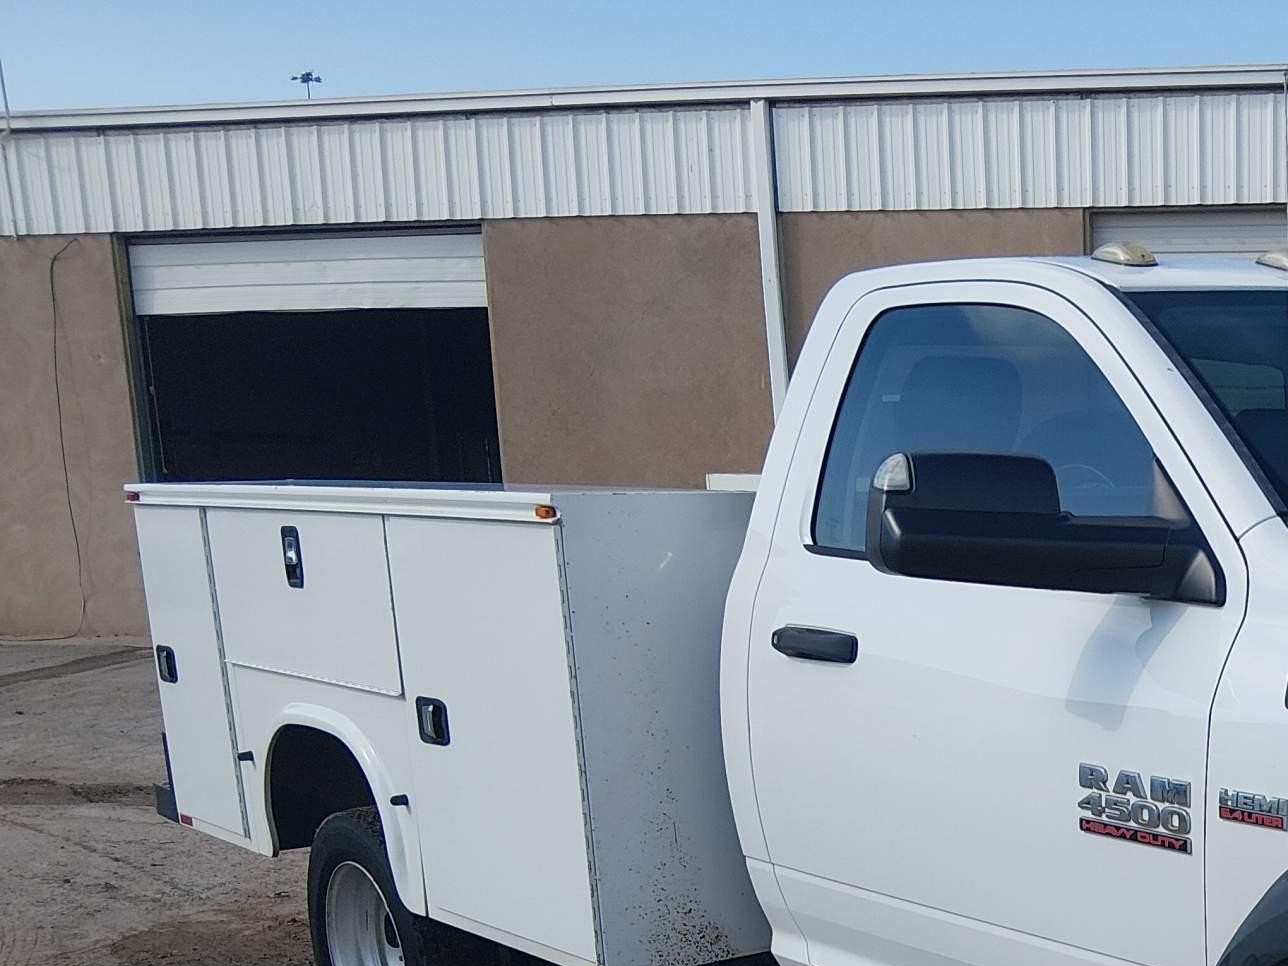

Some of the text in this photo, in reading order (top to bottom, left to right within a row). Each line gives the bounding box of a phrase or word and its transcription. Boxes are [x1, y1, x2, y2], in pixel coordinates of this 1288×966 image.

[1078, 762, 1191, 808] RAM
[1078, 791, 1191, 834] 4500
[1219, 788, 1288, 816] HEMI
[1082, 819, 1185, 850] HEAVY DUTY
[1244, 812, 1283, 828] LITER
